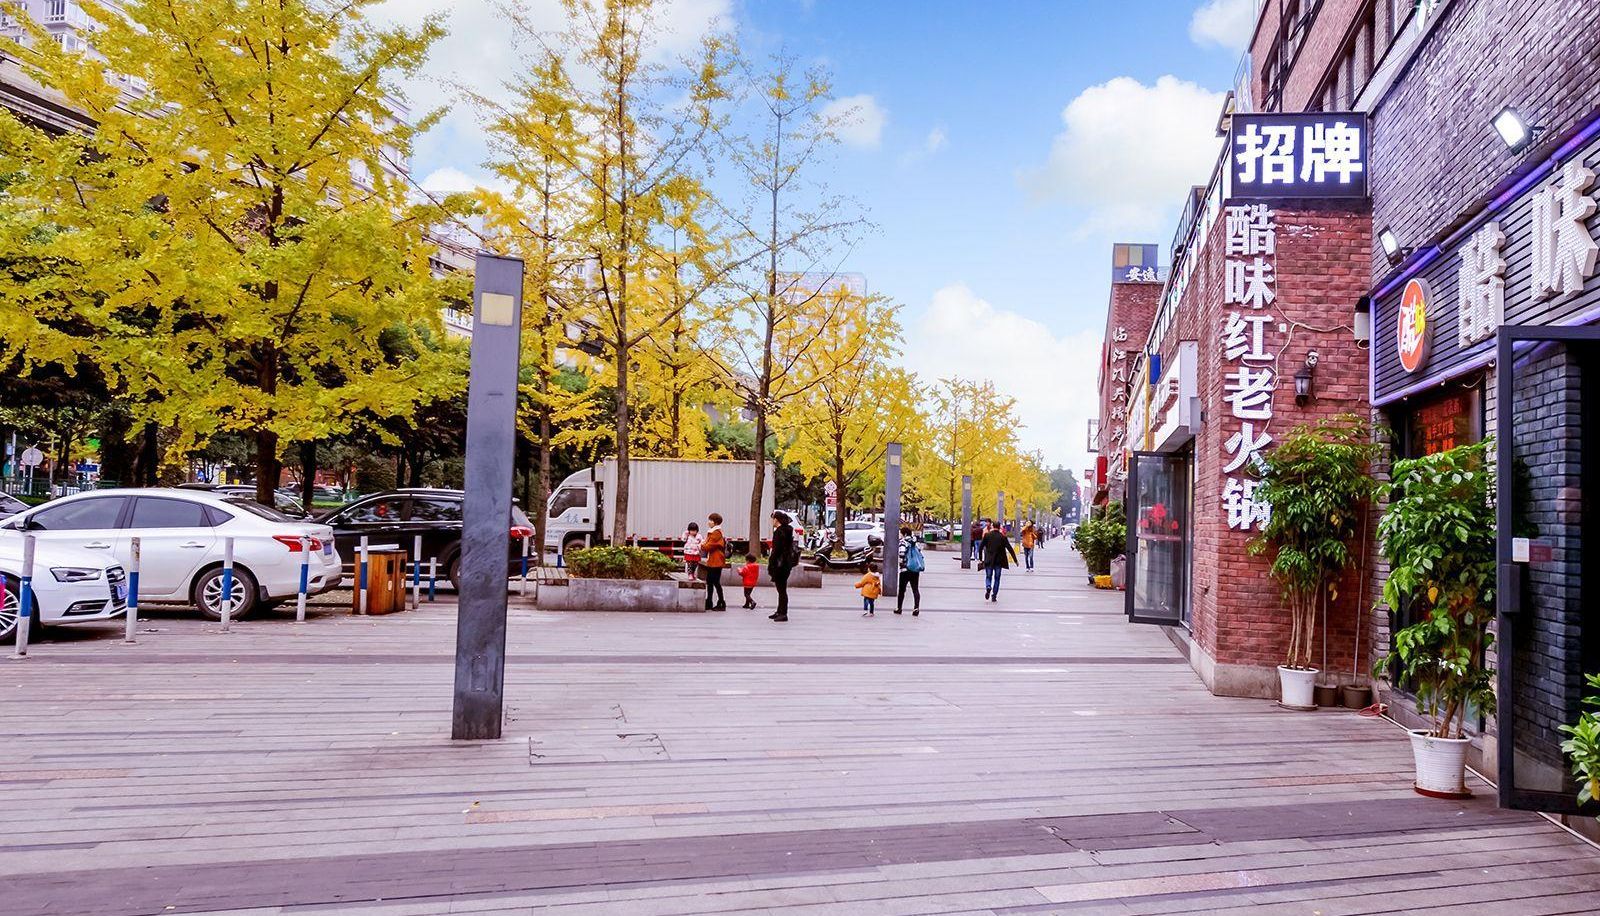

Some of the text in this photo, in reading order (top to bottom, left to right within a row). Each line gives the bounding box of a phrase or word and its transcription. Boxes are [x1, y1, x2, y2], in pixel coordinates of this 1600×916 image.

[1236, 121, 1363, 184] 招牌
[1458, 157, 1598, 349] 酷味
[1221, 203, 1277, 530] 酷味红老火锅
